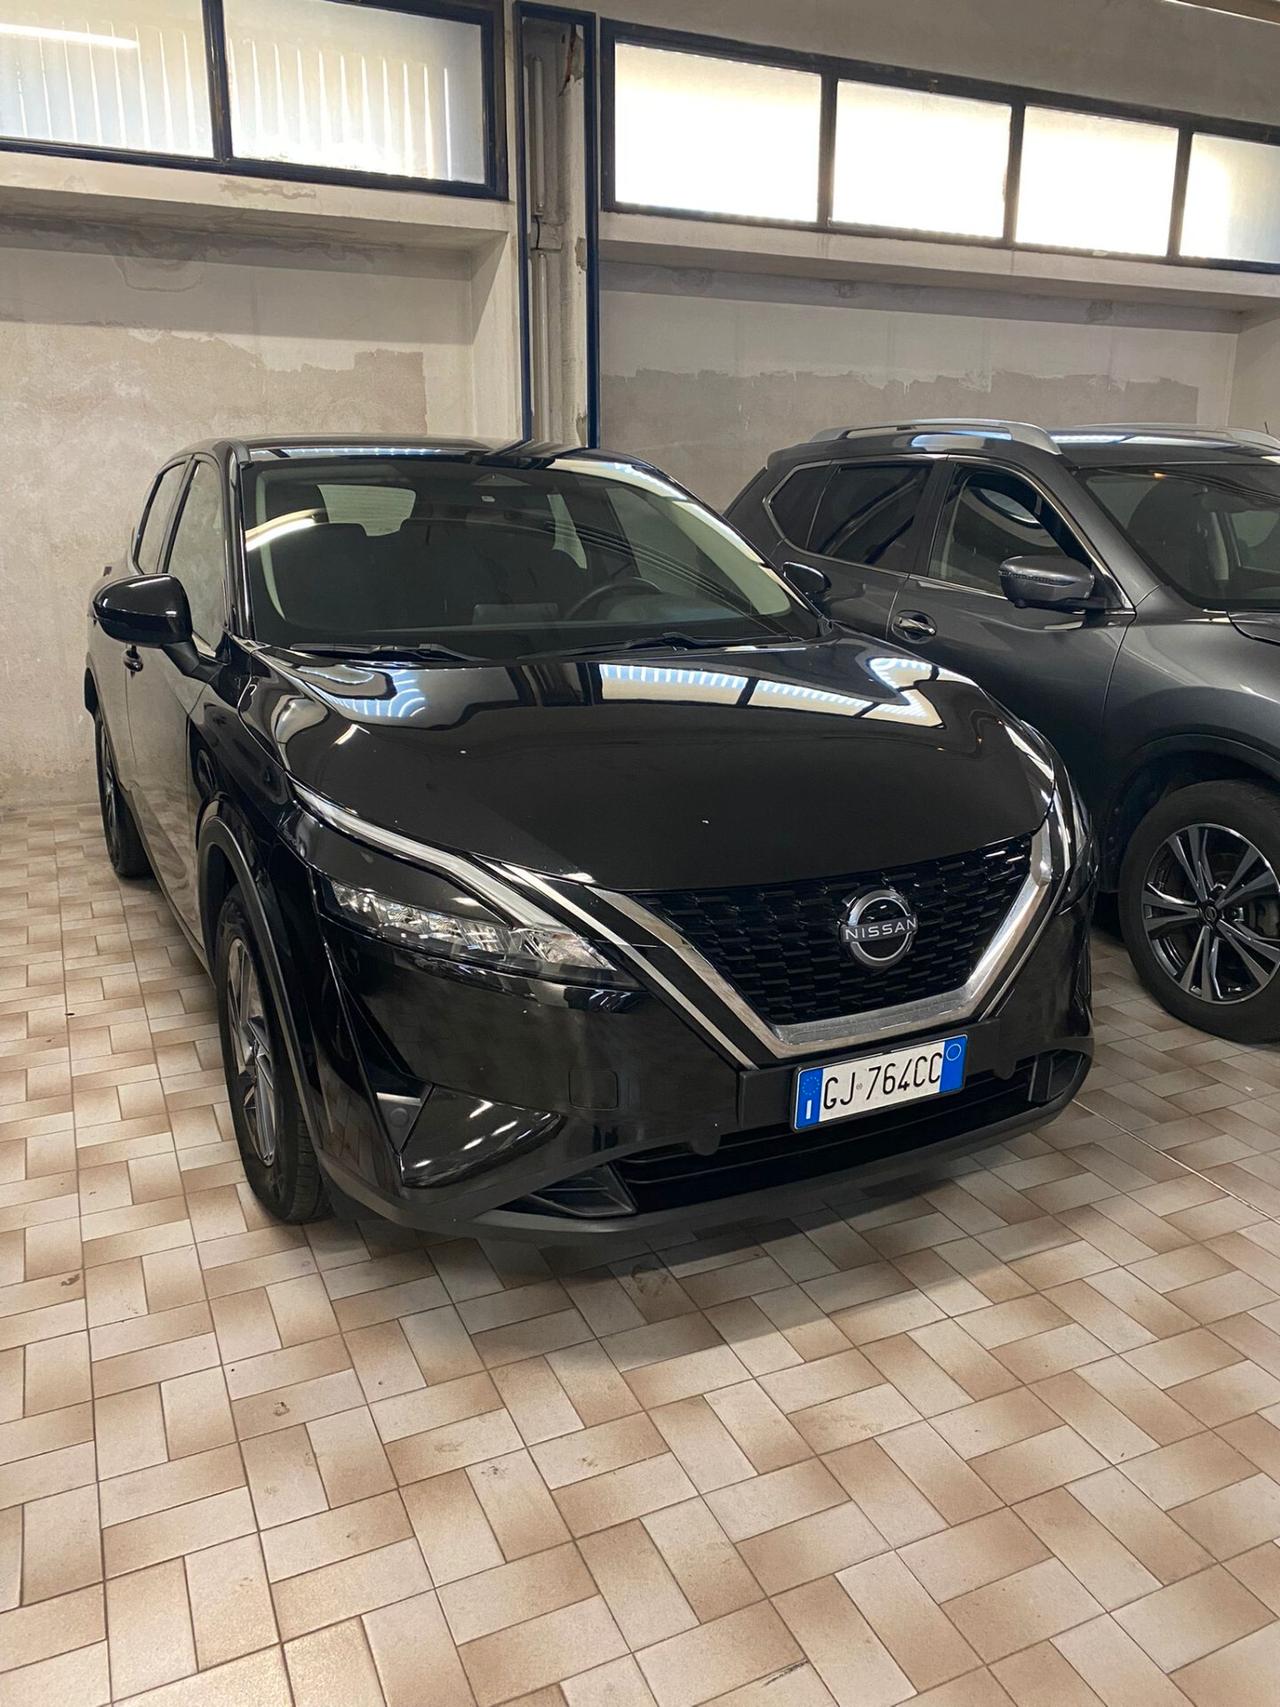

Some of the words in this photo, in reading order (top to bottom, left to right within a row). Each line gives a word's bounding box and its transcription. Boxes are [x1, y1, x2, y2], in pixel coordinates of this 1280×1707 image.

[845, 917, 917, 940] NISSAN
[823, 1072, 856, 1110] GJ
[866, 1052, 943, 1101] 764CC
